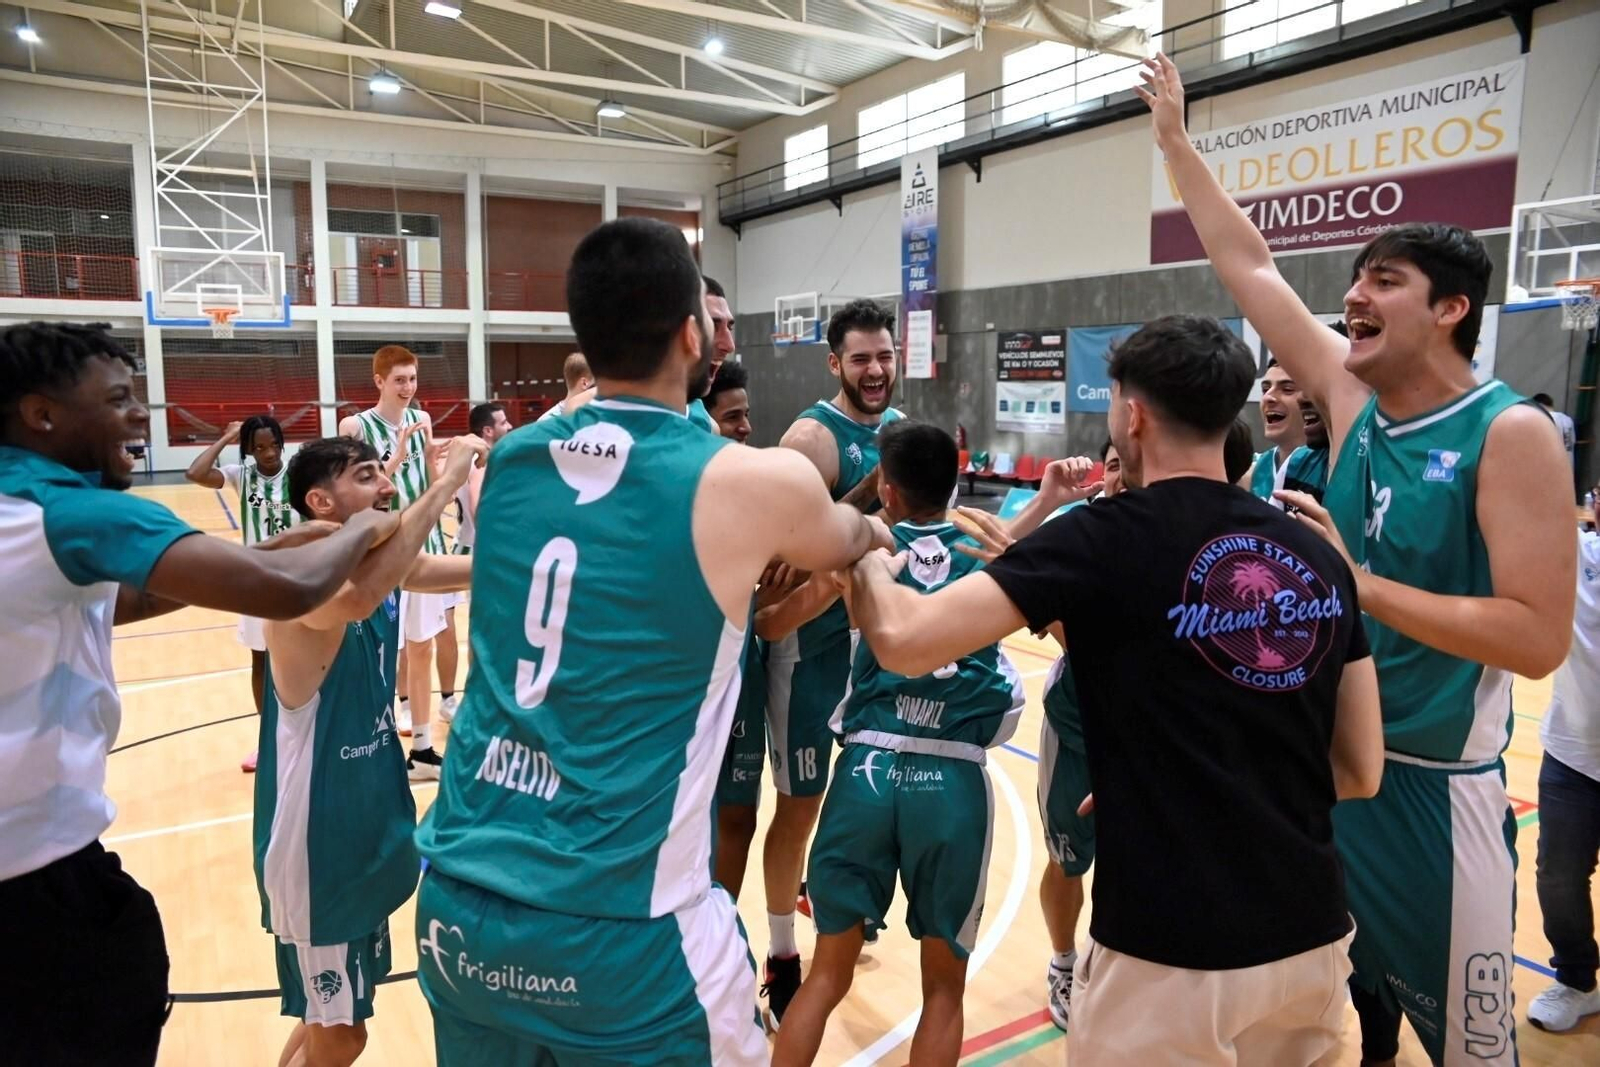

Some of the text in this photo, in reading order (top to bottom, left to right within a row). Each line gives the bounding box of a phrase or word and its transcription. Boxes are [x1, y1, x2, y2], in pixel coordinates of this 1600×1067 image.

[1192, 73, 1506, 154] ALACIÓN DEPORTIVA MUNICIPAL
[1164, 109, 1506, 202] VLDEOLLEROS
[1259, 181, 1403, 231] IMDECO
[1266, 234, 1297, 246] unicipal
[1299, 233, 1310, 242] de
[1312, 229, 1355, 241] Deportes
[1077, 384, 1110, 400] Cam
[1427, 469, 1446, 478] EBA
[1191, 537, 1315, 585] SUNSHINE STATE
[515, 536, 578, 710] 9
[1168, 585, 1343, 639] Miami Beach
[1232, 667, 1307, 688] CLOSURE
[795, 747, 817, 781] 18
[457, 952, 578, 993] frigiliana
